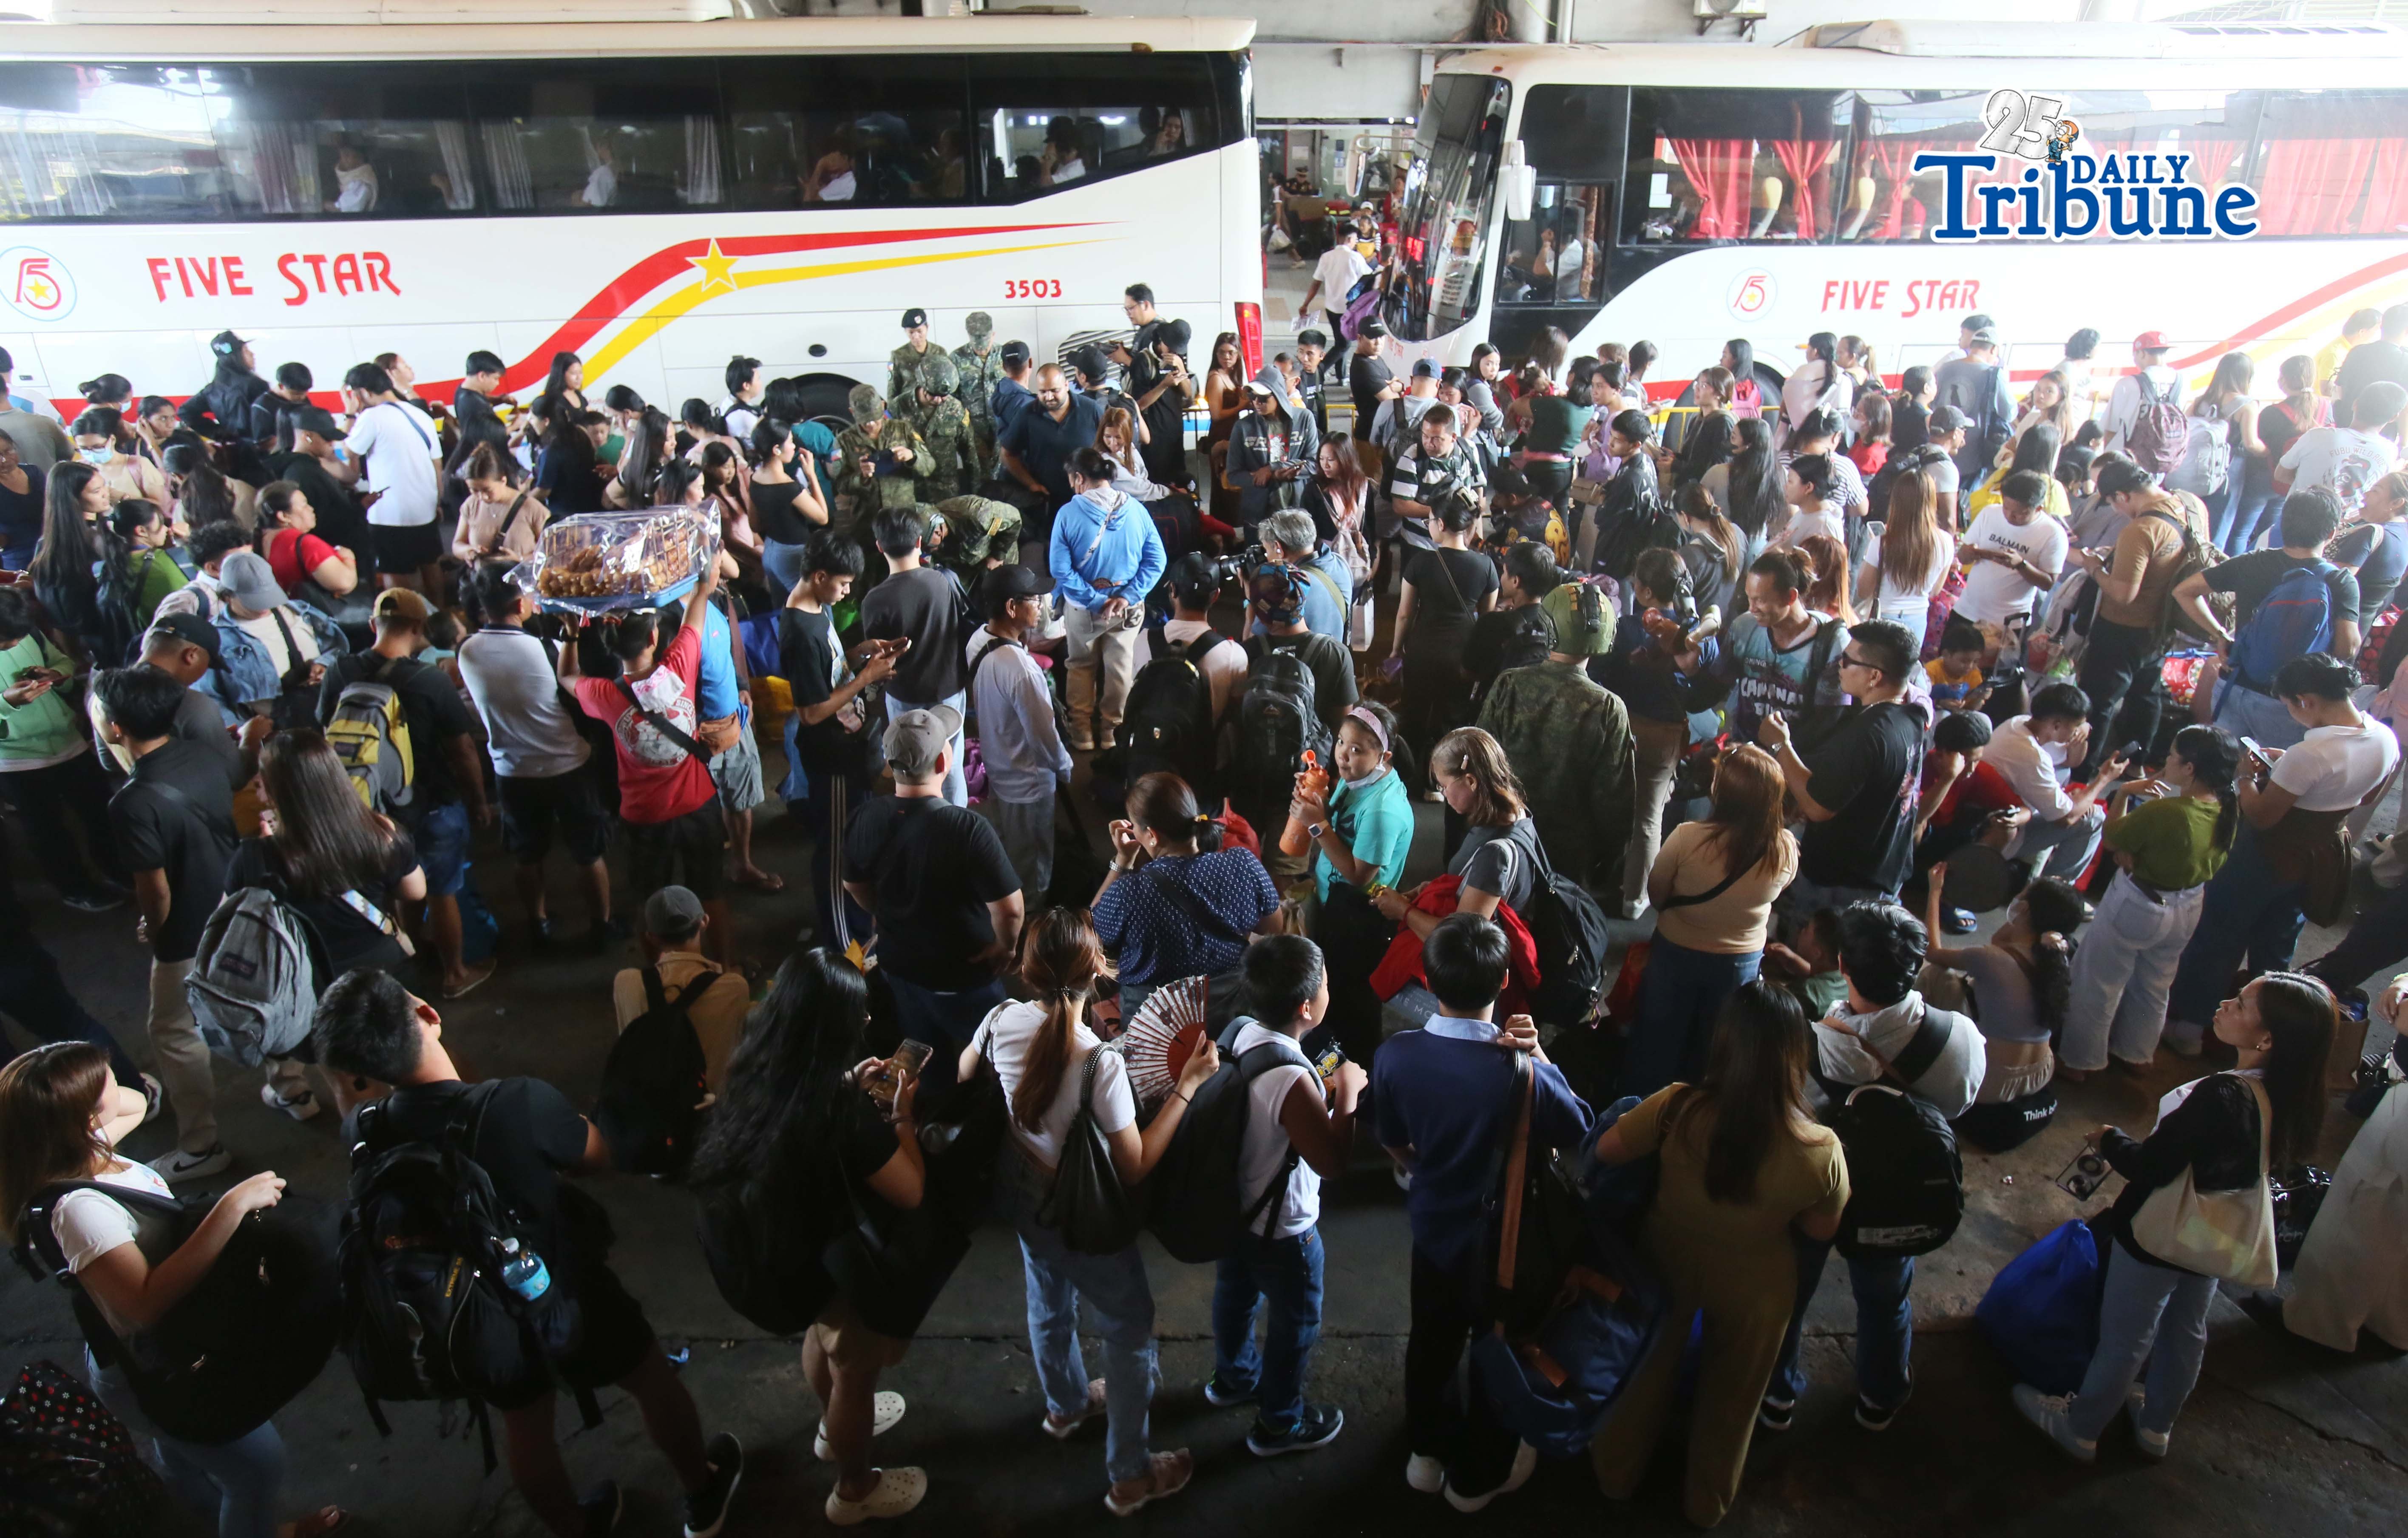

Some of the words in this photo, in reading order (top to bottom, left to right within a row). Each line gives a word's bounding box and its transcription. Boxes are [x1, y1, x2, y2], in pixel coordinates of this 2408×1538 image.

[146, 256, 253, 303] FIVE
[277, 251, 401, 306] STAR
[1005, 279, 1062, 299] 3503
[1821, 281, 1889, 313] FIVE
[1901, 280, 1980, 318] STAR
[2329, 447, 2351, 457] FUBU
[2353, 446, 2374, 457] WILD
[1989, 533, 2030, 554] BALMAIN
[2023, 1107, 2048, 1121] Think
